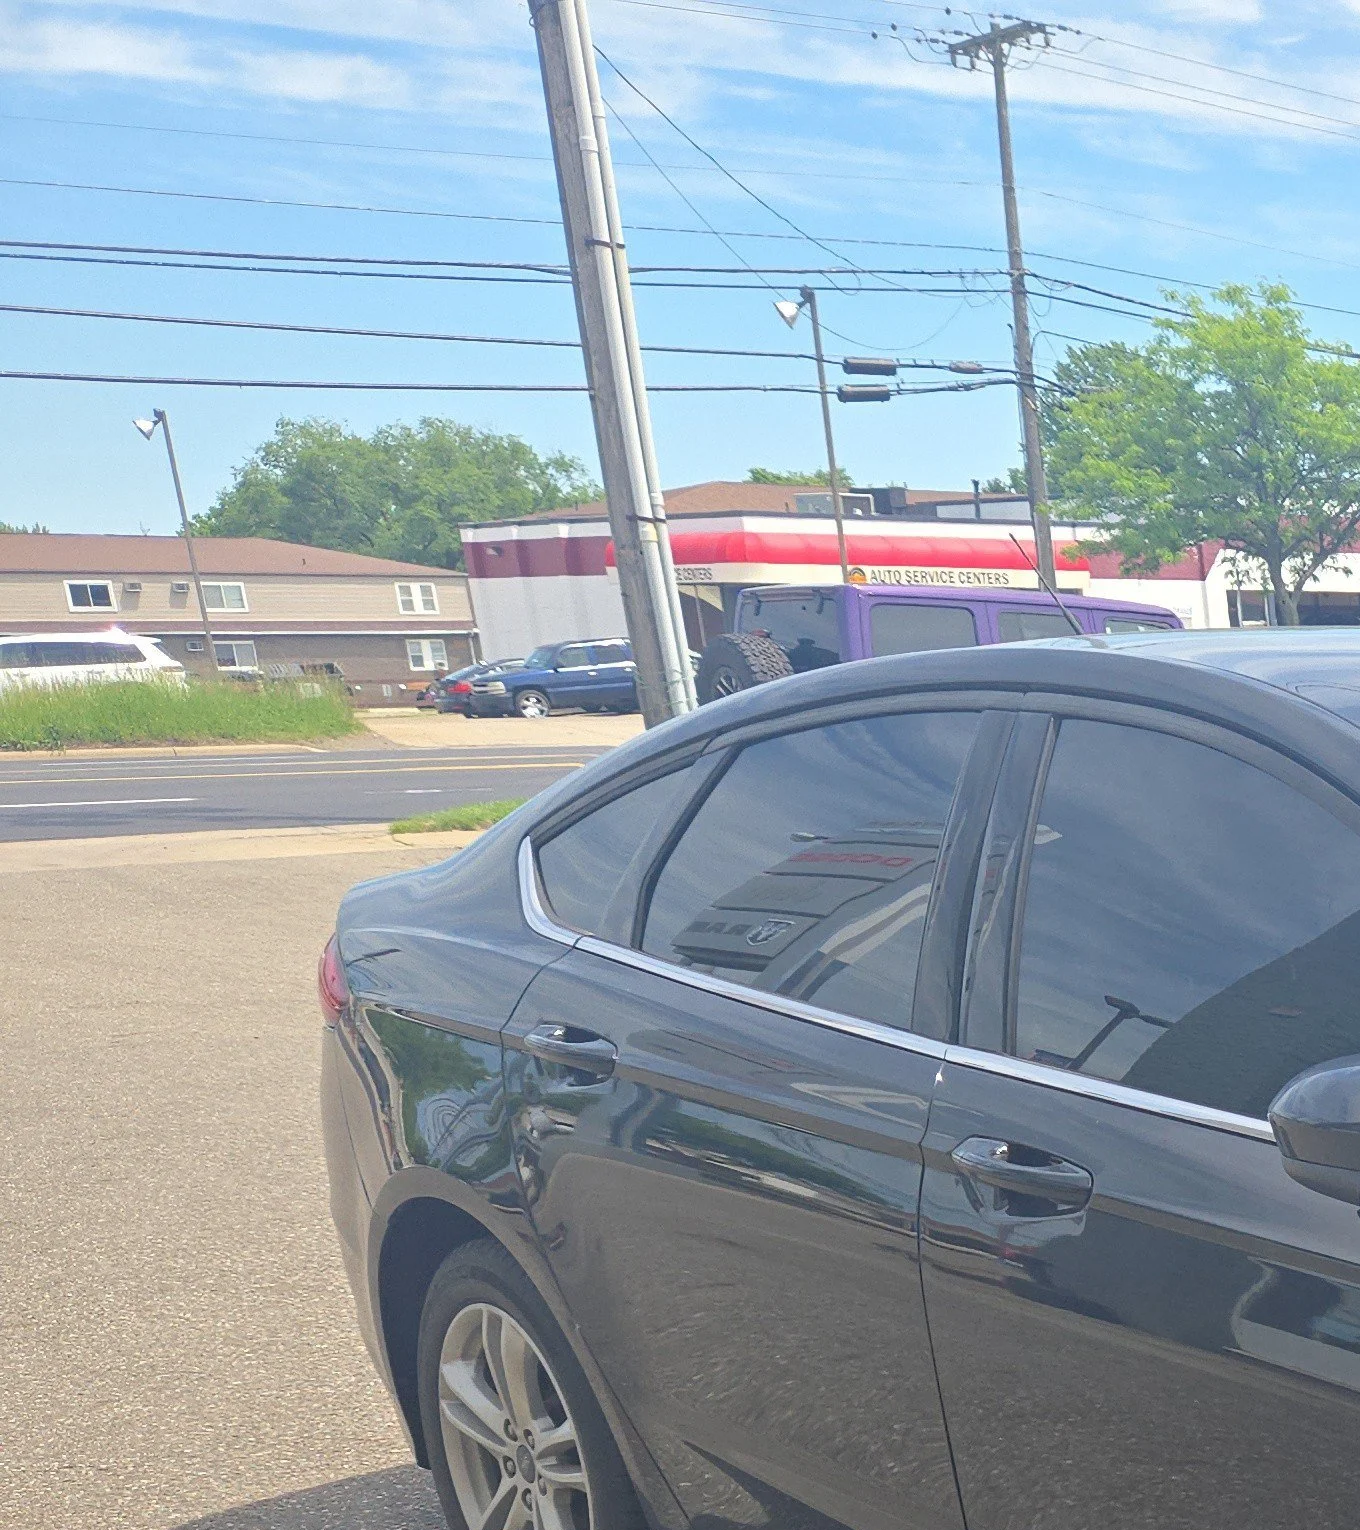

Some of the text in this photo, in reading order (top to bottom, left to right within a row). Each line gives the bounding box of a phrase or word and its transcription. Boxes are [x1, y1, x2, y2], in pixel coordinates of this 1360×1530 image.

[869, 569, 1010, 585] AUTO SERVICE CENTERS
